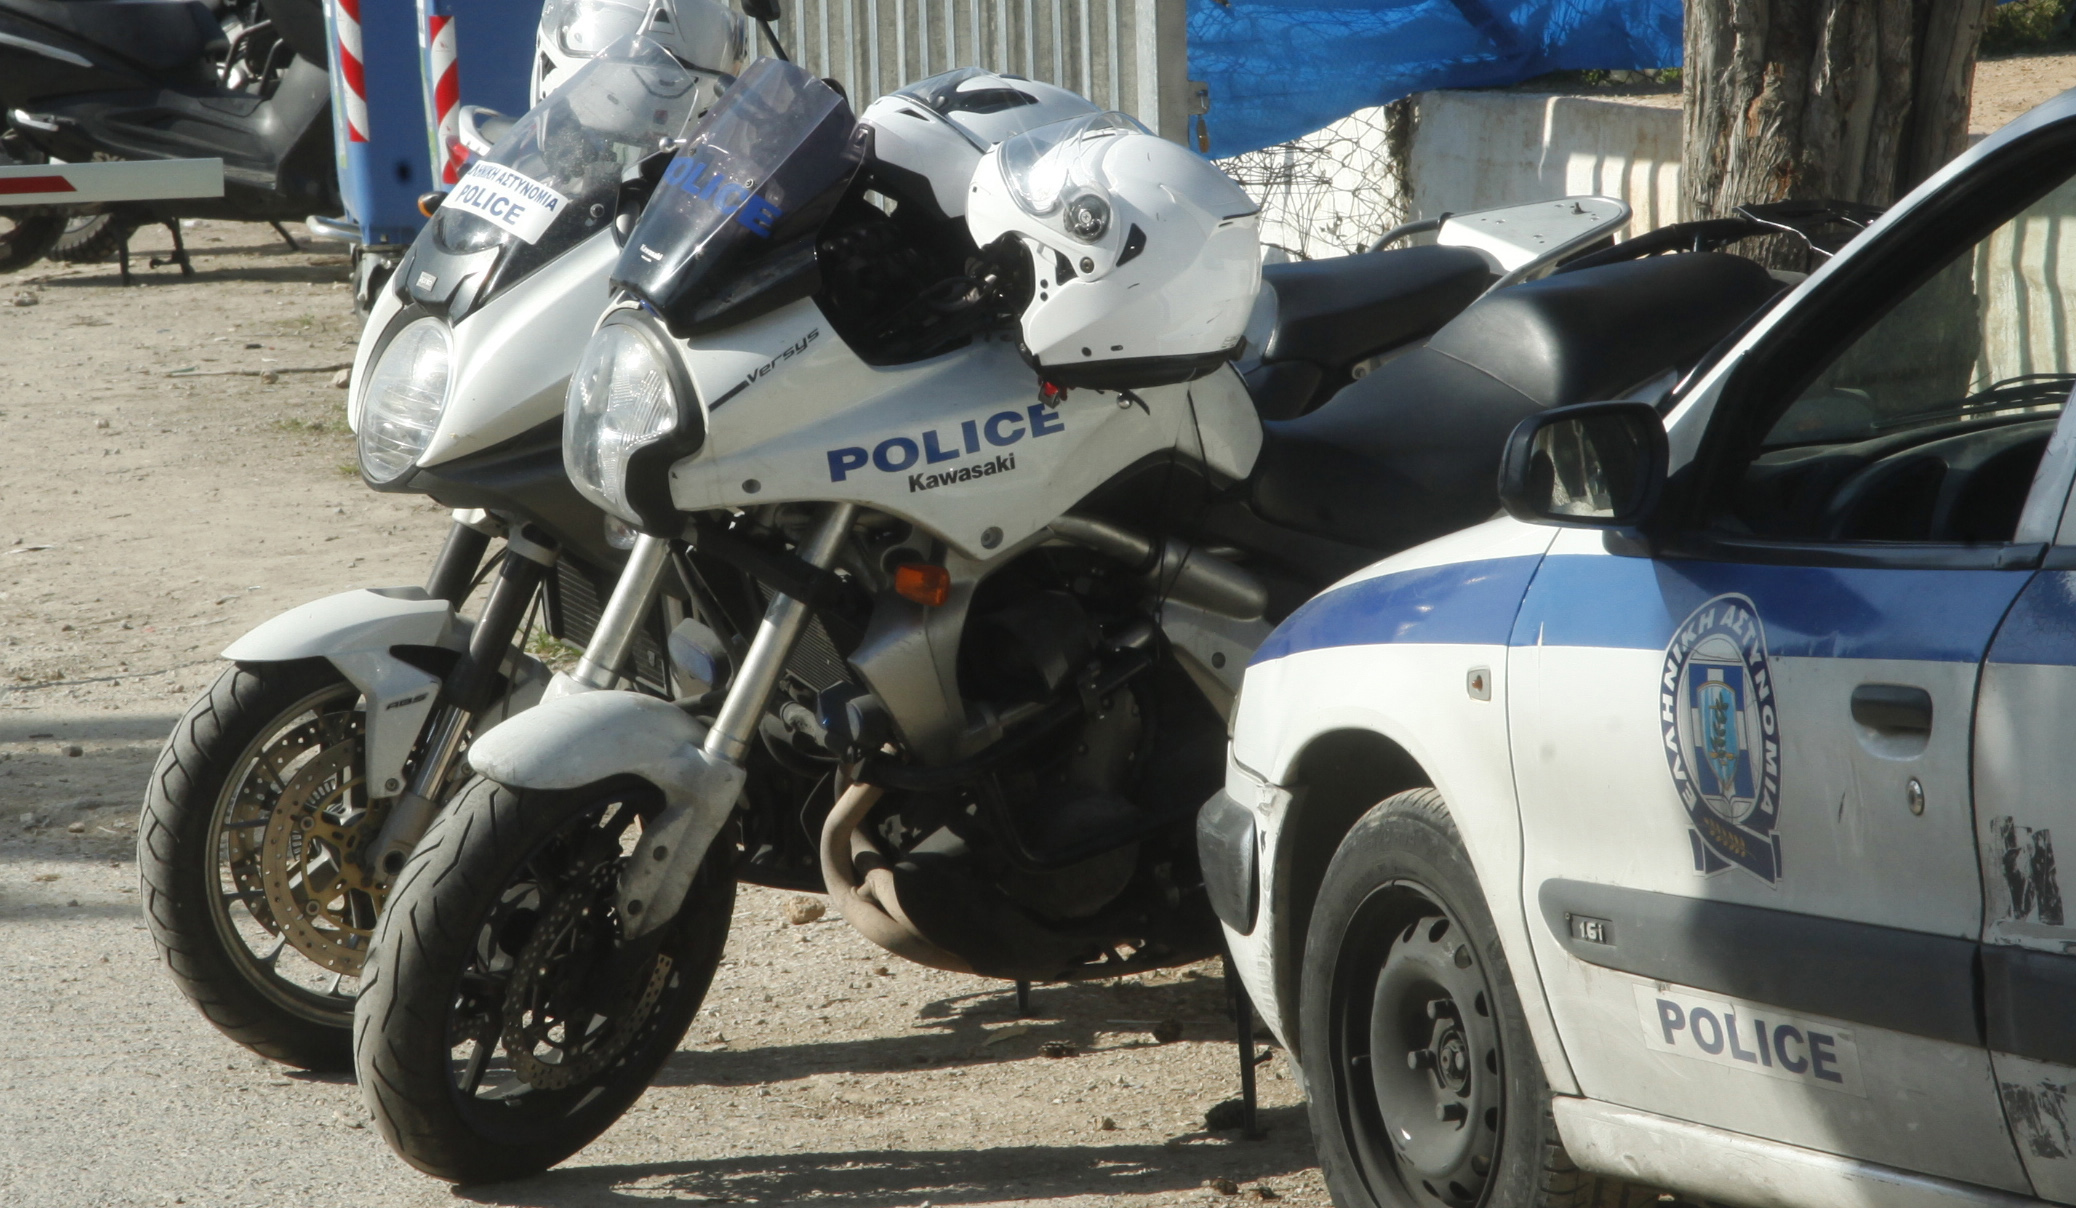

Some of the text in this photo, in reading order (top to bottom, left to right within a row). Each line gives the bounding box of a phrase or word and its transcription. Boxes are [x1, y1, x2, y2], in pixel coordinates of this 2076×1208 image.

[455, 184, 526, 225] POLICE
[495, 172, 559, 212] ΑΣΤΥΝΟΜΙΑ
[663, 156, 784, 239] OLICE
[746, 327, 820, 383] Versys
[826, 402, 1065, 482] POLICE
[908, 452, 1016, 493] Kawasaki
[1661, 604, 1778, 816] ΕΛΛΗΝΙΚΗ ΑΣΤΥΝΟΜΙΑ
[1655, 997, 1843, 1084] POLICE
